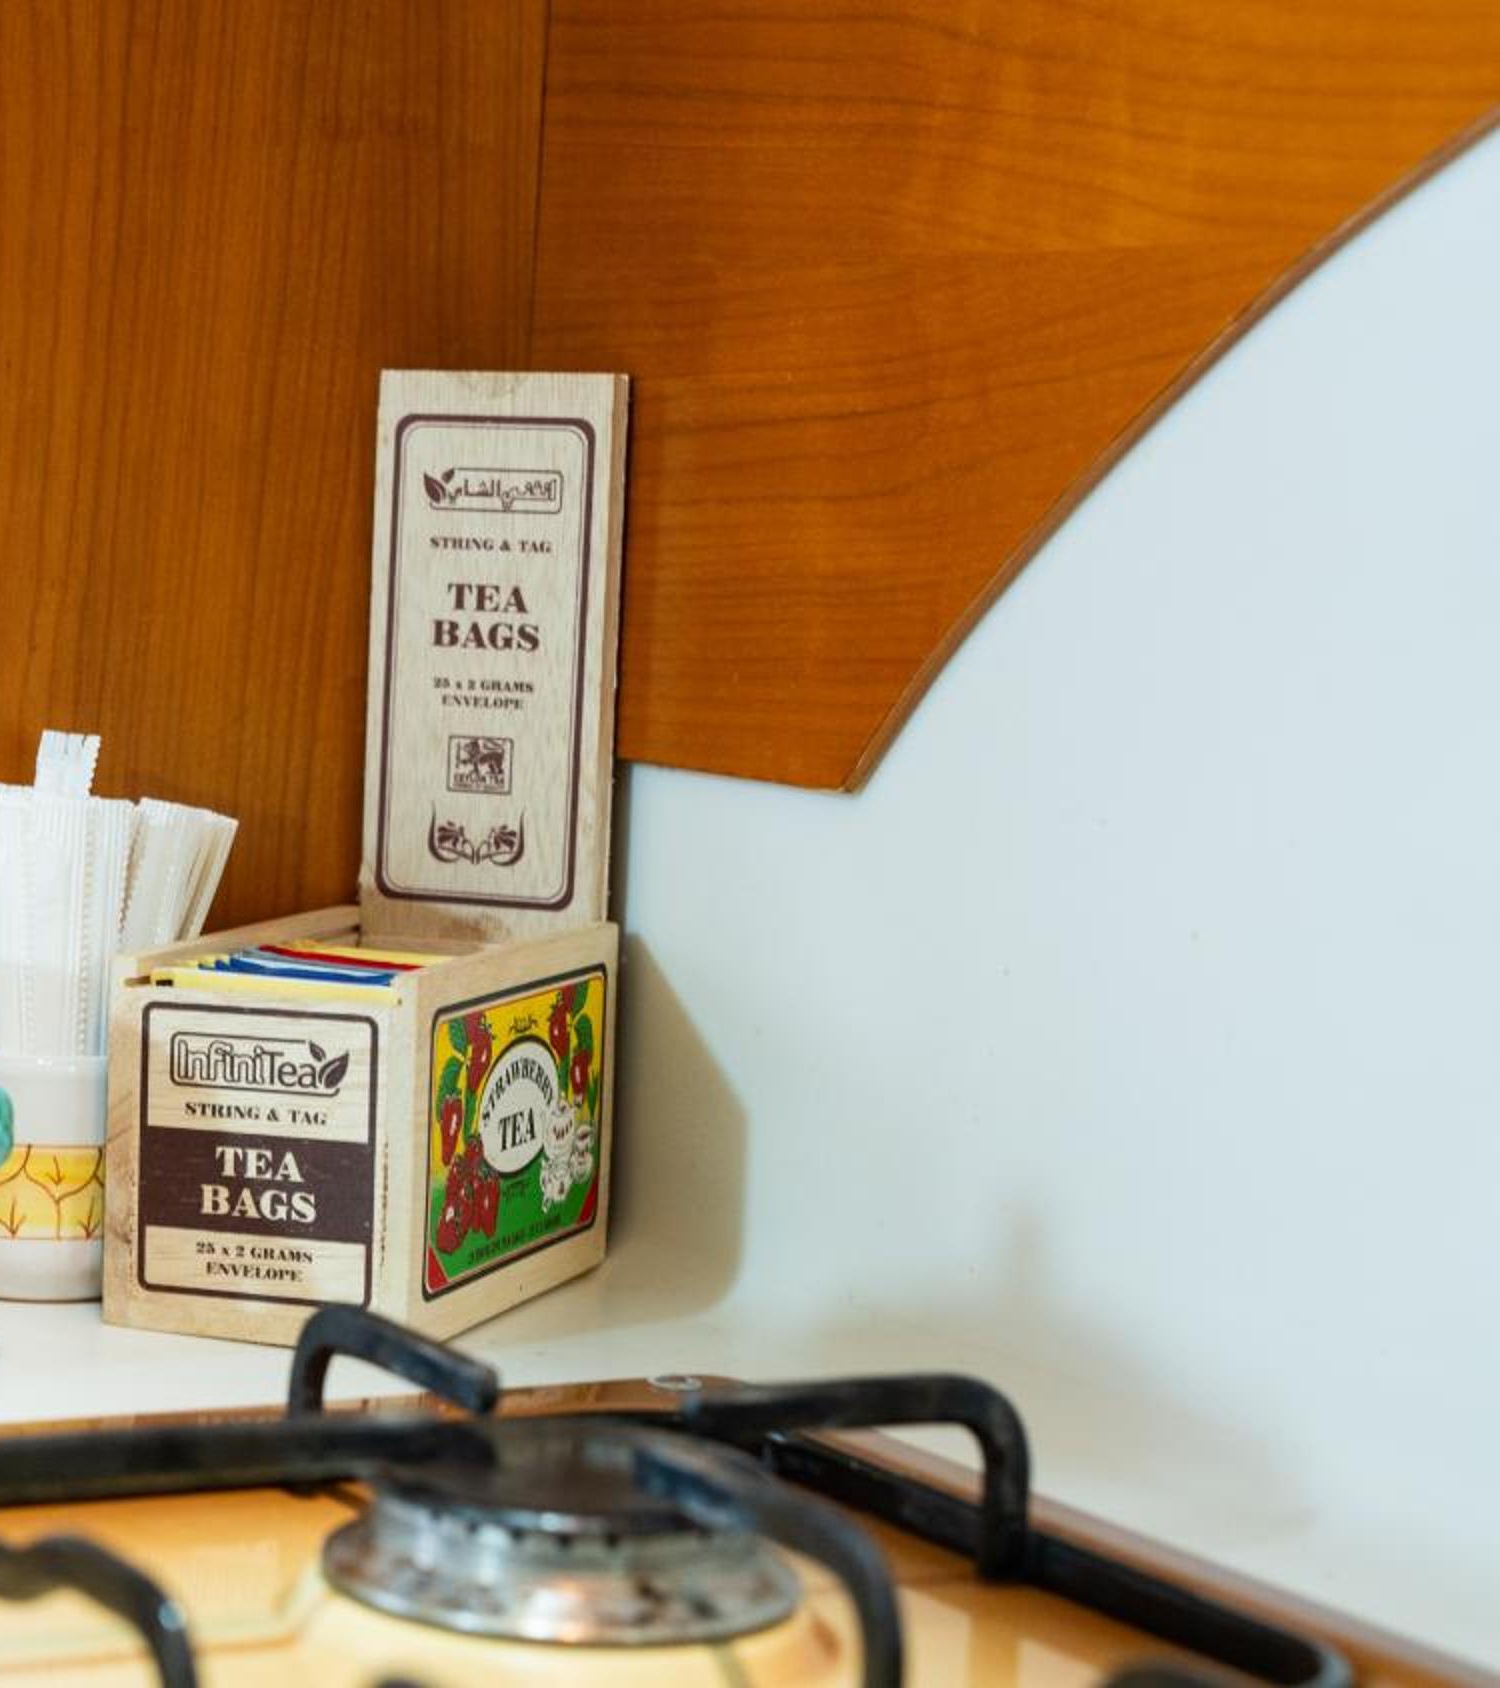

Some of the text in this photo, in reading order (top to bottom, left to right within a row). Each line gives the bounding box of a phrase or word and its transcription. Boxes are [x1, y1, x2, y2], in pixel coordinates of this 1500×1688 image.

[429, 536, 553, 554] STRING & TAG
[447, 582, 529, 614] TEA
[432, 620, 541, 652] BAGS
[433, 677, 451, 690] 25
[466, 679, 475, 691] 2
[480, 680, 535, 693] GRAMS
[441, 695, 524, 710] ENVELOPE
[176, 1039, 319, 1090] InfiniTea
[481, 1055, 556, 1129] STRAWBERRY
[185, 1101, 329, 1127] STRING & TAG
[497, 1107, 538, 1152] TEA
[215, 1145, 305, 1184] TEA
[200, 1183, 318, 1225] BAGS
[196, 1241, 216, 1255] 25
[235, 1244, 246, 1258] 2
[250, 1245, 314, 1264] GRAMS
[206, 1261, 304, 1283] ENVELOPE
